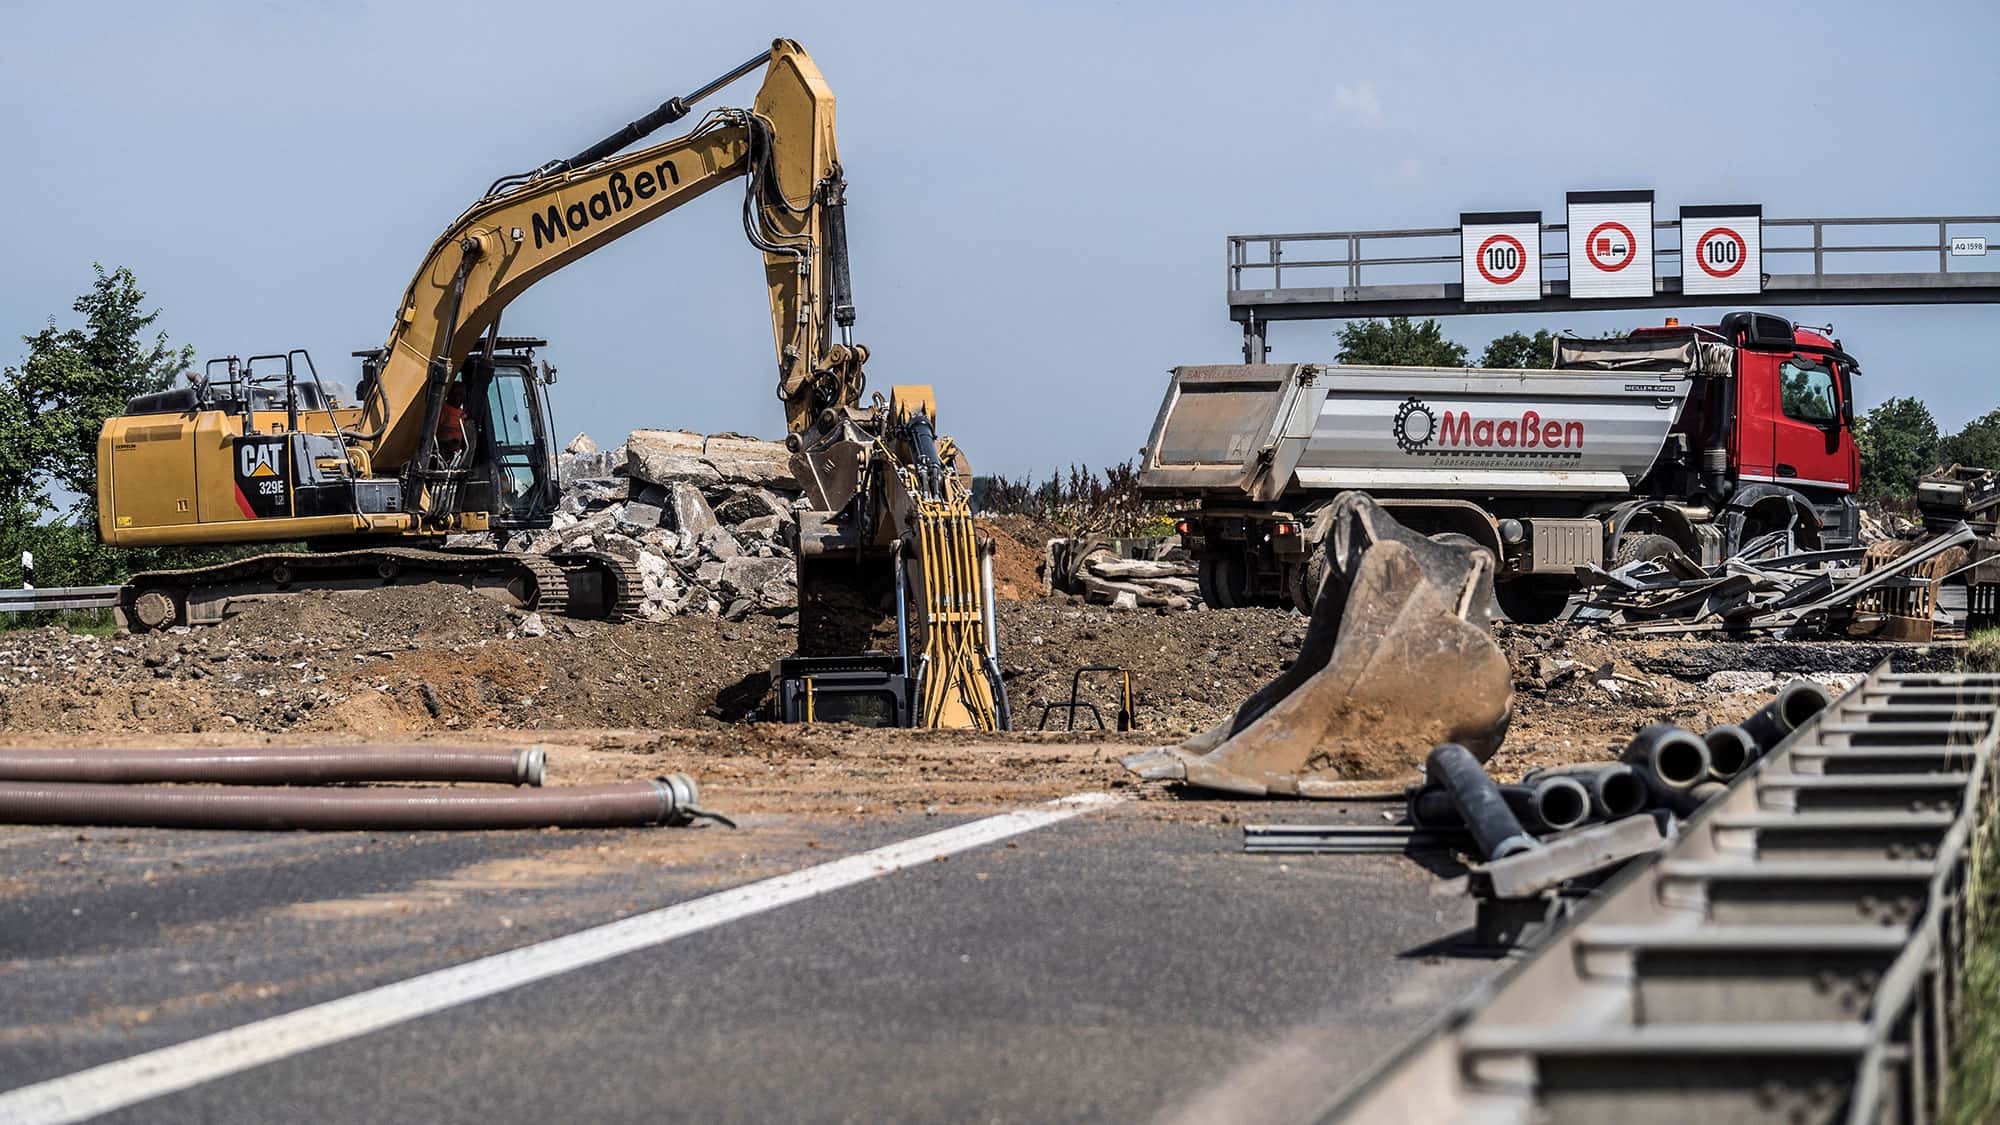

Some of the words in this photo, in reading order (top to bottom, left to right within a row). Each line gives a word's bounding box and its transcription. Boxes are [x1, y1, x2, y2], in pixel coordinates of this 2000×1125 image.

[532, 160, 679, 249] Maaßen
[1486, 247, 1517, 270] 100
[1705, 241, 1737, 263] 100
[1438, 410, 1584, 448] Maaßen
[241, 443, 282, 477] CAT
[259, 480, 284, 494] 329E
